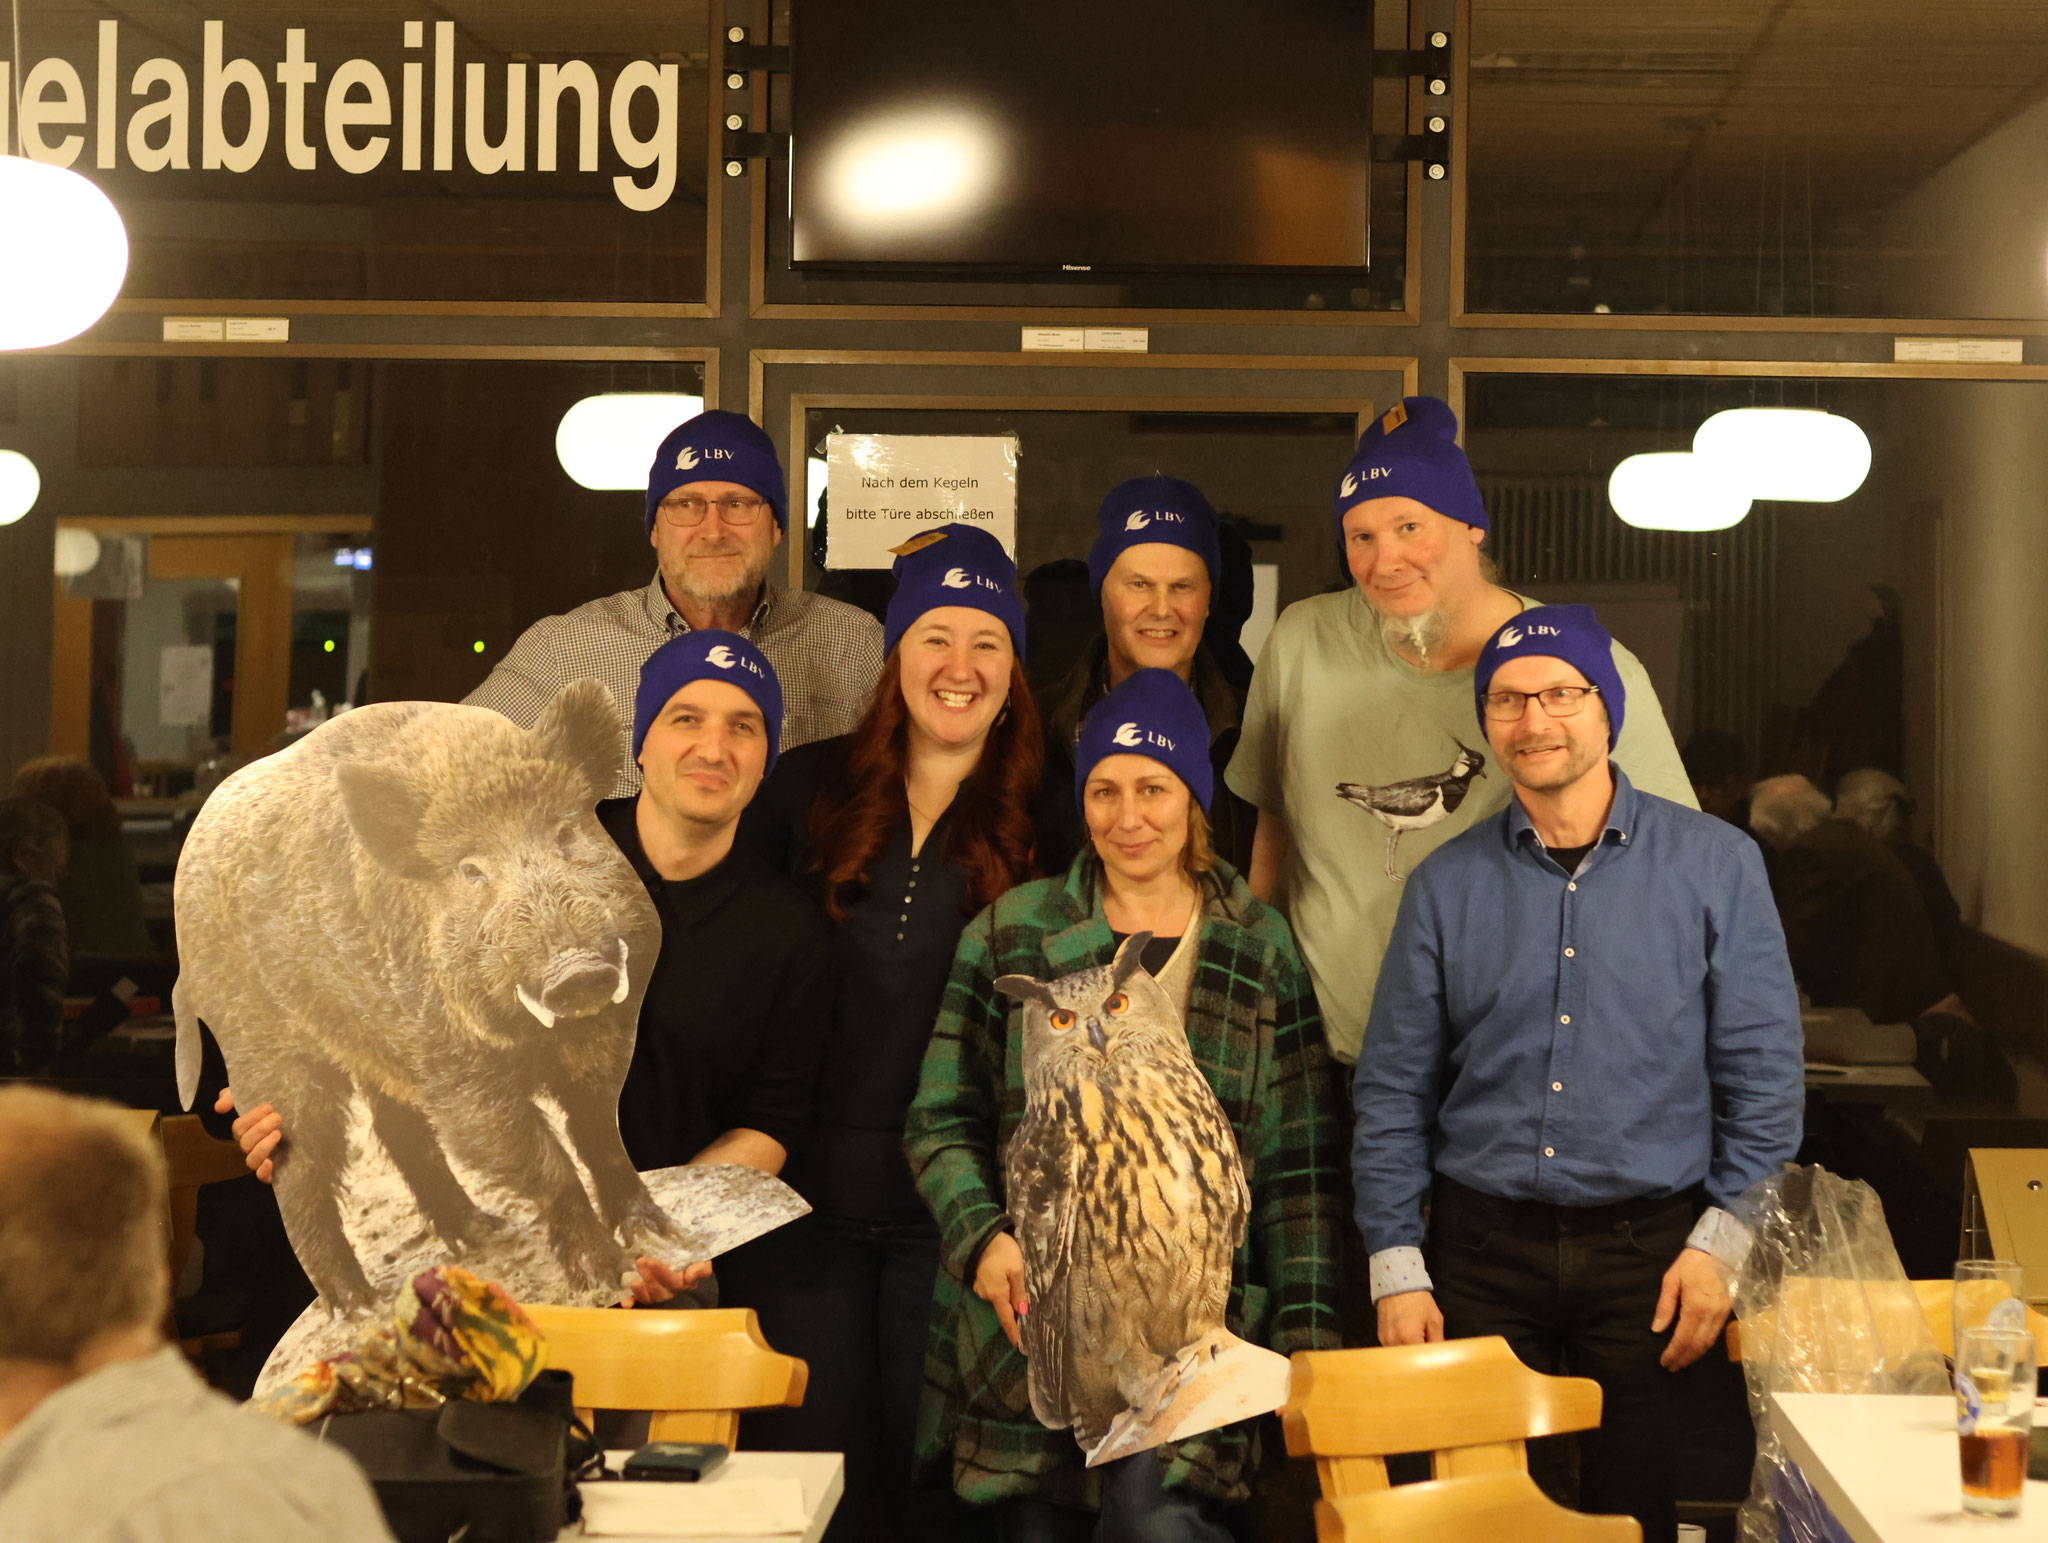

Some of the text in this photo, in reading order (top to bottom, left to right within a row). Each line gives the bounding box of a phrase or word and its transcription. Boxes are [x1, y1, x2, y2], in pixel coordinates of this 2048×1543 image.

[0, 20, 679, 211] elabteilung
[704, 448, 735, 461] LBV
[1361, 467, 1393, 482] LBV
[862, 477, 979, 491] Nach dem Kegeln
[846, 508, 877, 520] bitte
[881, 508, 911, 520] Türe
[1155, 510, 1185, 524] LBV
[976, 574, 1003, 595] LBV
[1528, 625, 1561, 637] LBV
[740, 656, 766, 679] LBV
[1147, 730, 1176, 752] LBV
